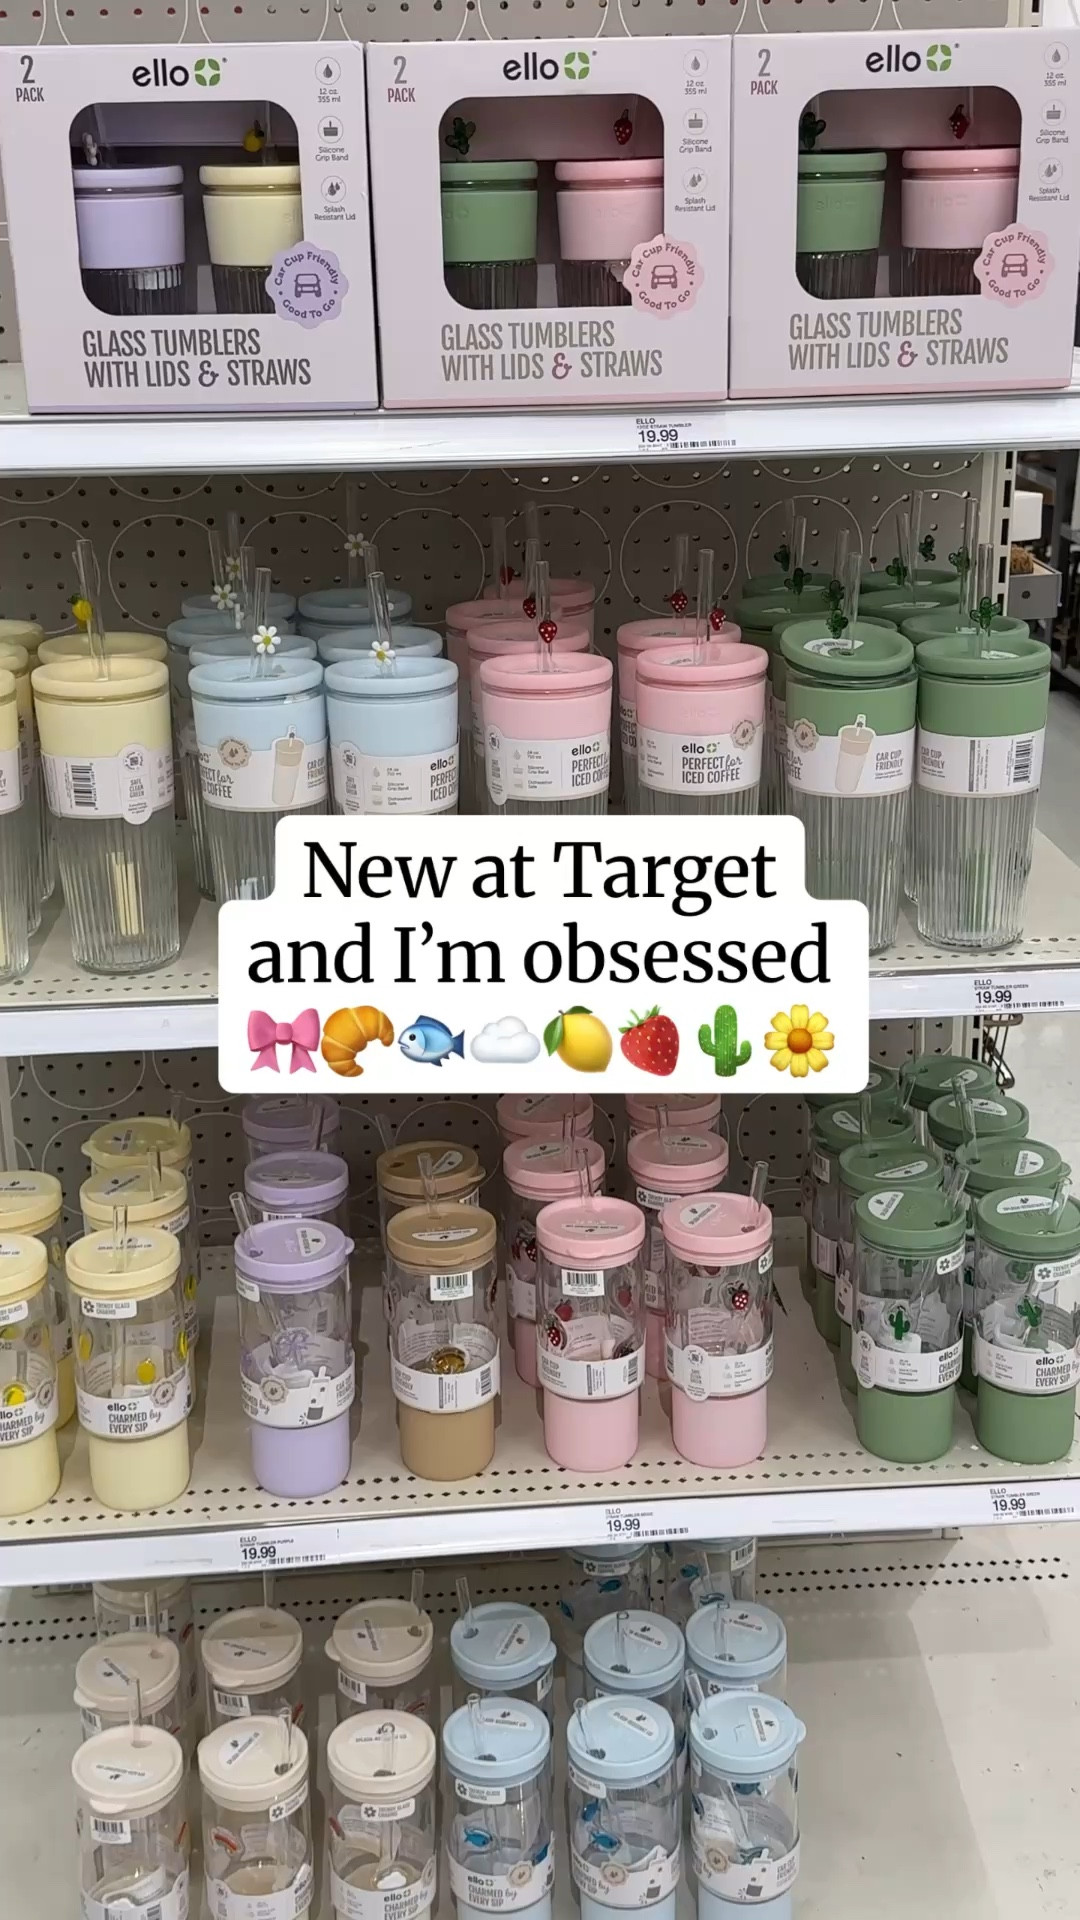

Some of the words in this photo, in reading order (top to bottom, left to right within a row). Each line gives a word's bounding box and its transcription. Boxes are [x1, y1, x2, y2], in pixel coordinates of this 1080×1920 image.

[758, 49, 771, 77] 2
[866, 45, 921, 72] ello
[20, 55, 34, 83] 2
[132, 58, 189, 87] ello
[394, 56, 407, 84] 2
[503, 52, 559, 80] ello
[16, 88, 44, 102] PACK
[388, 88, 415, 102] PACK
[751, 81, 778, 95] PACK
[324, 206, 345, 214] Splash
[983, 248, 995, 266] Car
[994, 234, 1014, 247] Cup
[1018, 232, 1046, 264] Friendly
[632, 260, 643, 277] Car
[643, 245, 662, 258] Cup
[666, 243, 695, 275] Friendly
[275, 267, 285, 285] Car
[284, 253, 304, 266] Cup
[307, 252, 338, 284] Friendly
[989, 279, 1011, 298] Good
[1014, 290, 1026, 298] To
[1028, 278, 1039, 290] Go
[639, 291, 662, 310] Good
[664, 302, 677, 310] To
[678, 290, 690, 302] Go
[283, 300, 307, 318] Good
[309, 310, 322, 319] To
[323, 299, 335, 311] Go
[789, 313, 850, 340] GLASS
[857, 309, 962, 338] TUMBLERS
[441, 324, 502, 350] GLASS
[508, 321, 615, 349] TUMBLERS
[83, 330, 146, 357] GLASS
[151, 329, 260, 356] TUMBLERS
[789, 344, 840, 370] WITH
[847, 343, 890, 369] LIDS
[898, 341, 918, 368] &
[926, 338, 1008, 365] STRAWS
[442, 355, 494, 381] WITH
[500, 354, 544, 380] LIDS
[552, 353, 572, 379] &
[581, 351, 662, 378] STRAWS
[84, 361, 138, 388] WITH
[147, 361, 190, 387] LIDS
[198, 361, 219, 387] &
[228, 359, 311, 386] STRAWS
[638, 429, 678, 442] 19.99
[572, 745, 591, 756] ello
[682, 744, 704, 754] ello
[876, 752, 888, 761] CAR
[891, 750, 902, 760] CUP
[931, 749, 942, 759] CUP
[431, 759, 447, 771] ello
[572, 753, 603, 772] PERFECT
[682, 756, 724, 770] PERFECT
[725, 754, 742, 771] for
[876, 759, 904, 771] FRIENDLY
[217, 769, 233, 784] for
[572, 774, 590, 786] ICED
[682, 771, 704, 784] ICED
[708, 768, 740, 783] COFFEE
[208, 783, 232, 798] COFFEE
[431, 787, 447, 801] ICED
[976, 990, 1012, 1003] 19.99
[939, 1351, 952, 1361] ello
[1036, 1357, 1054, 1365] ello
[1036, 1364, 1070, 1376] CHARMED
[1036, 1377, 1058, 1387] EVERY
[1060, 1374, 1070, 1384] SIP
[0, 1410, 12, 1419] llo
[108, 1404, 126, 1412] ello
[35, 1412, 45, 1424] by
[109, 1412, 147, 1423] CHARMED
[150, 1410, 161, 1423] by
[0, 1430, 19, 1441] VERY
[21, 1427, 34, 1438] SIP
[109, 1423, 133, 1433] EVERY
[135, 1423, 148, 1432] SIP
[993, 1498, 1025, 1511] 19.99
[607, 1518, 640, 1532] 19.99
[242, 1546, 276, 1560] 19.99
[468, 1876, 484, 1885] ello
[384, 1893, 402, 1902] ello
[469, 1884, 502, 1897] CHARMED
[385, 1895, 418, 1912] CHARMED
